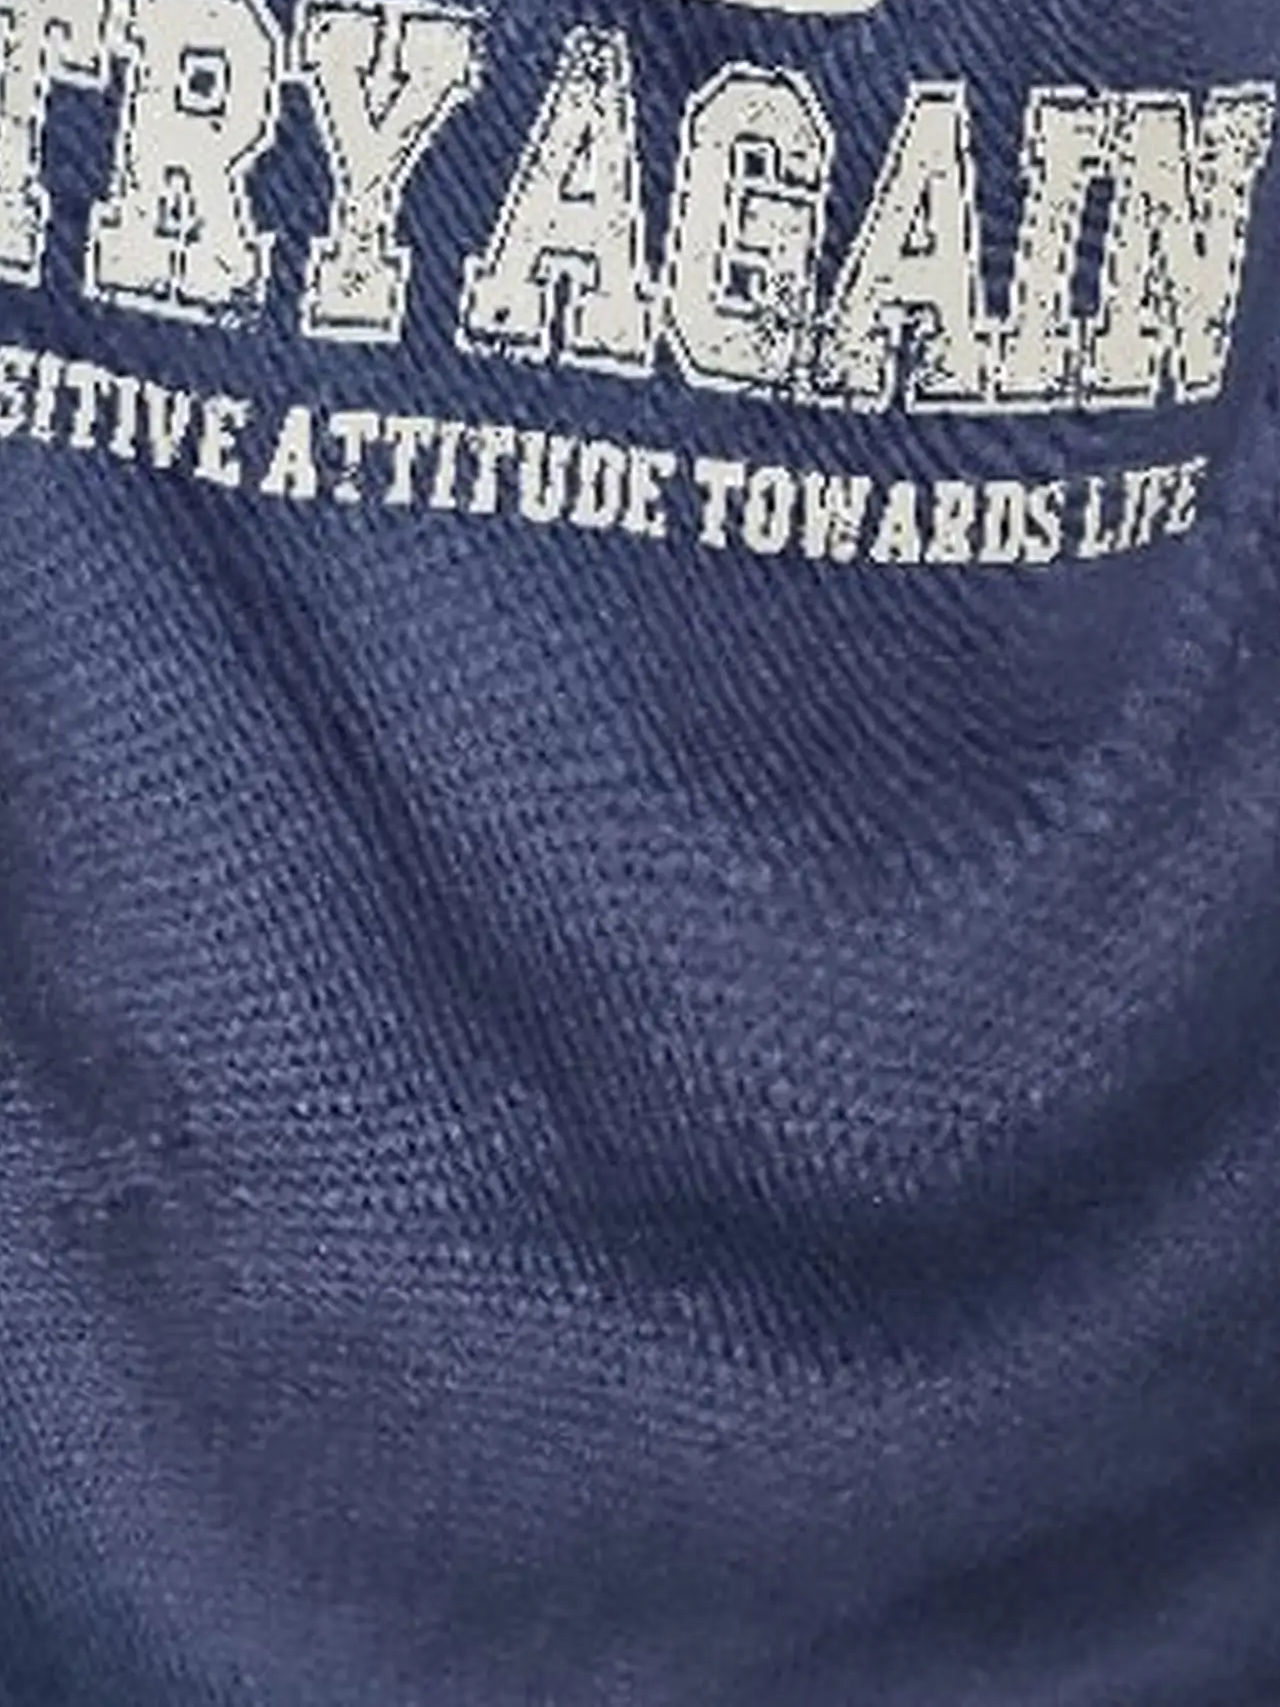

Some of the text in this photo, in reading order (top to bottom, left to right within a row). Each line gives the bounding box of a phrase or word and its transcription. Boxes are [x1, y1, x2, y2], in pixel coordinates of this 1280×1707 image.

[454, 24, 1277, 415] AGAIN
[260, 406, 677, 536] ATTITUDE
[693, 458, 1066, 564] TOWARDS
[1078, 456, 1209, 560] LIFE
